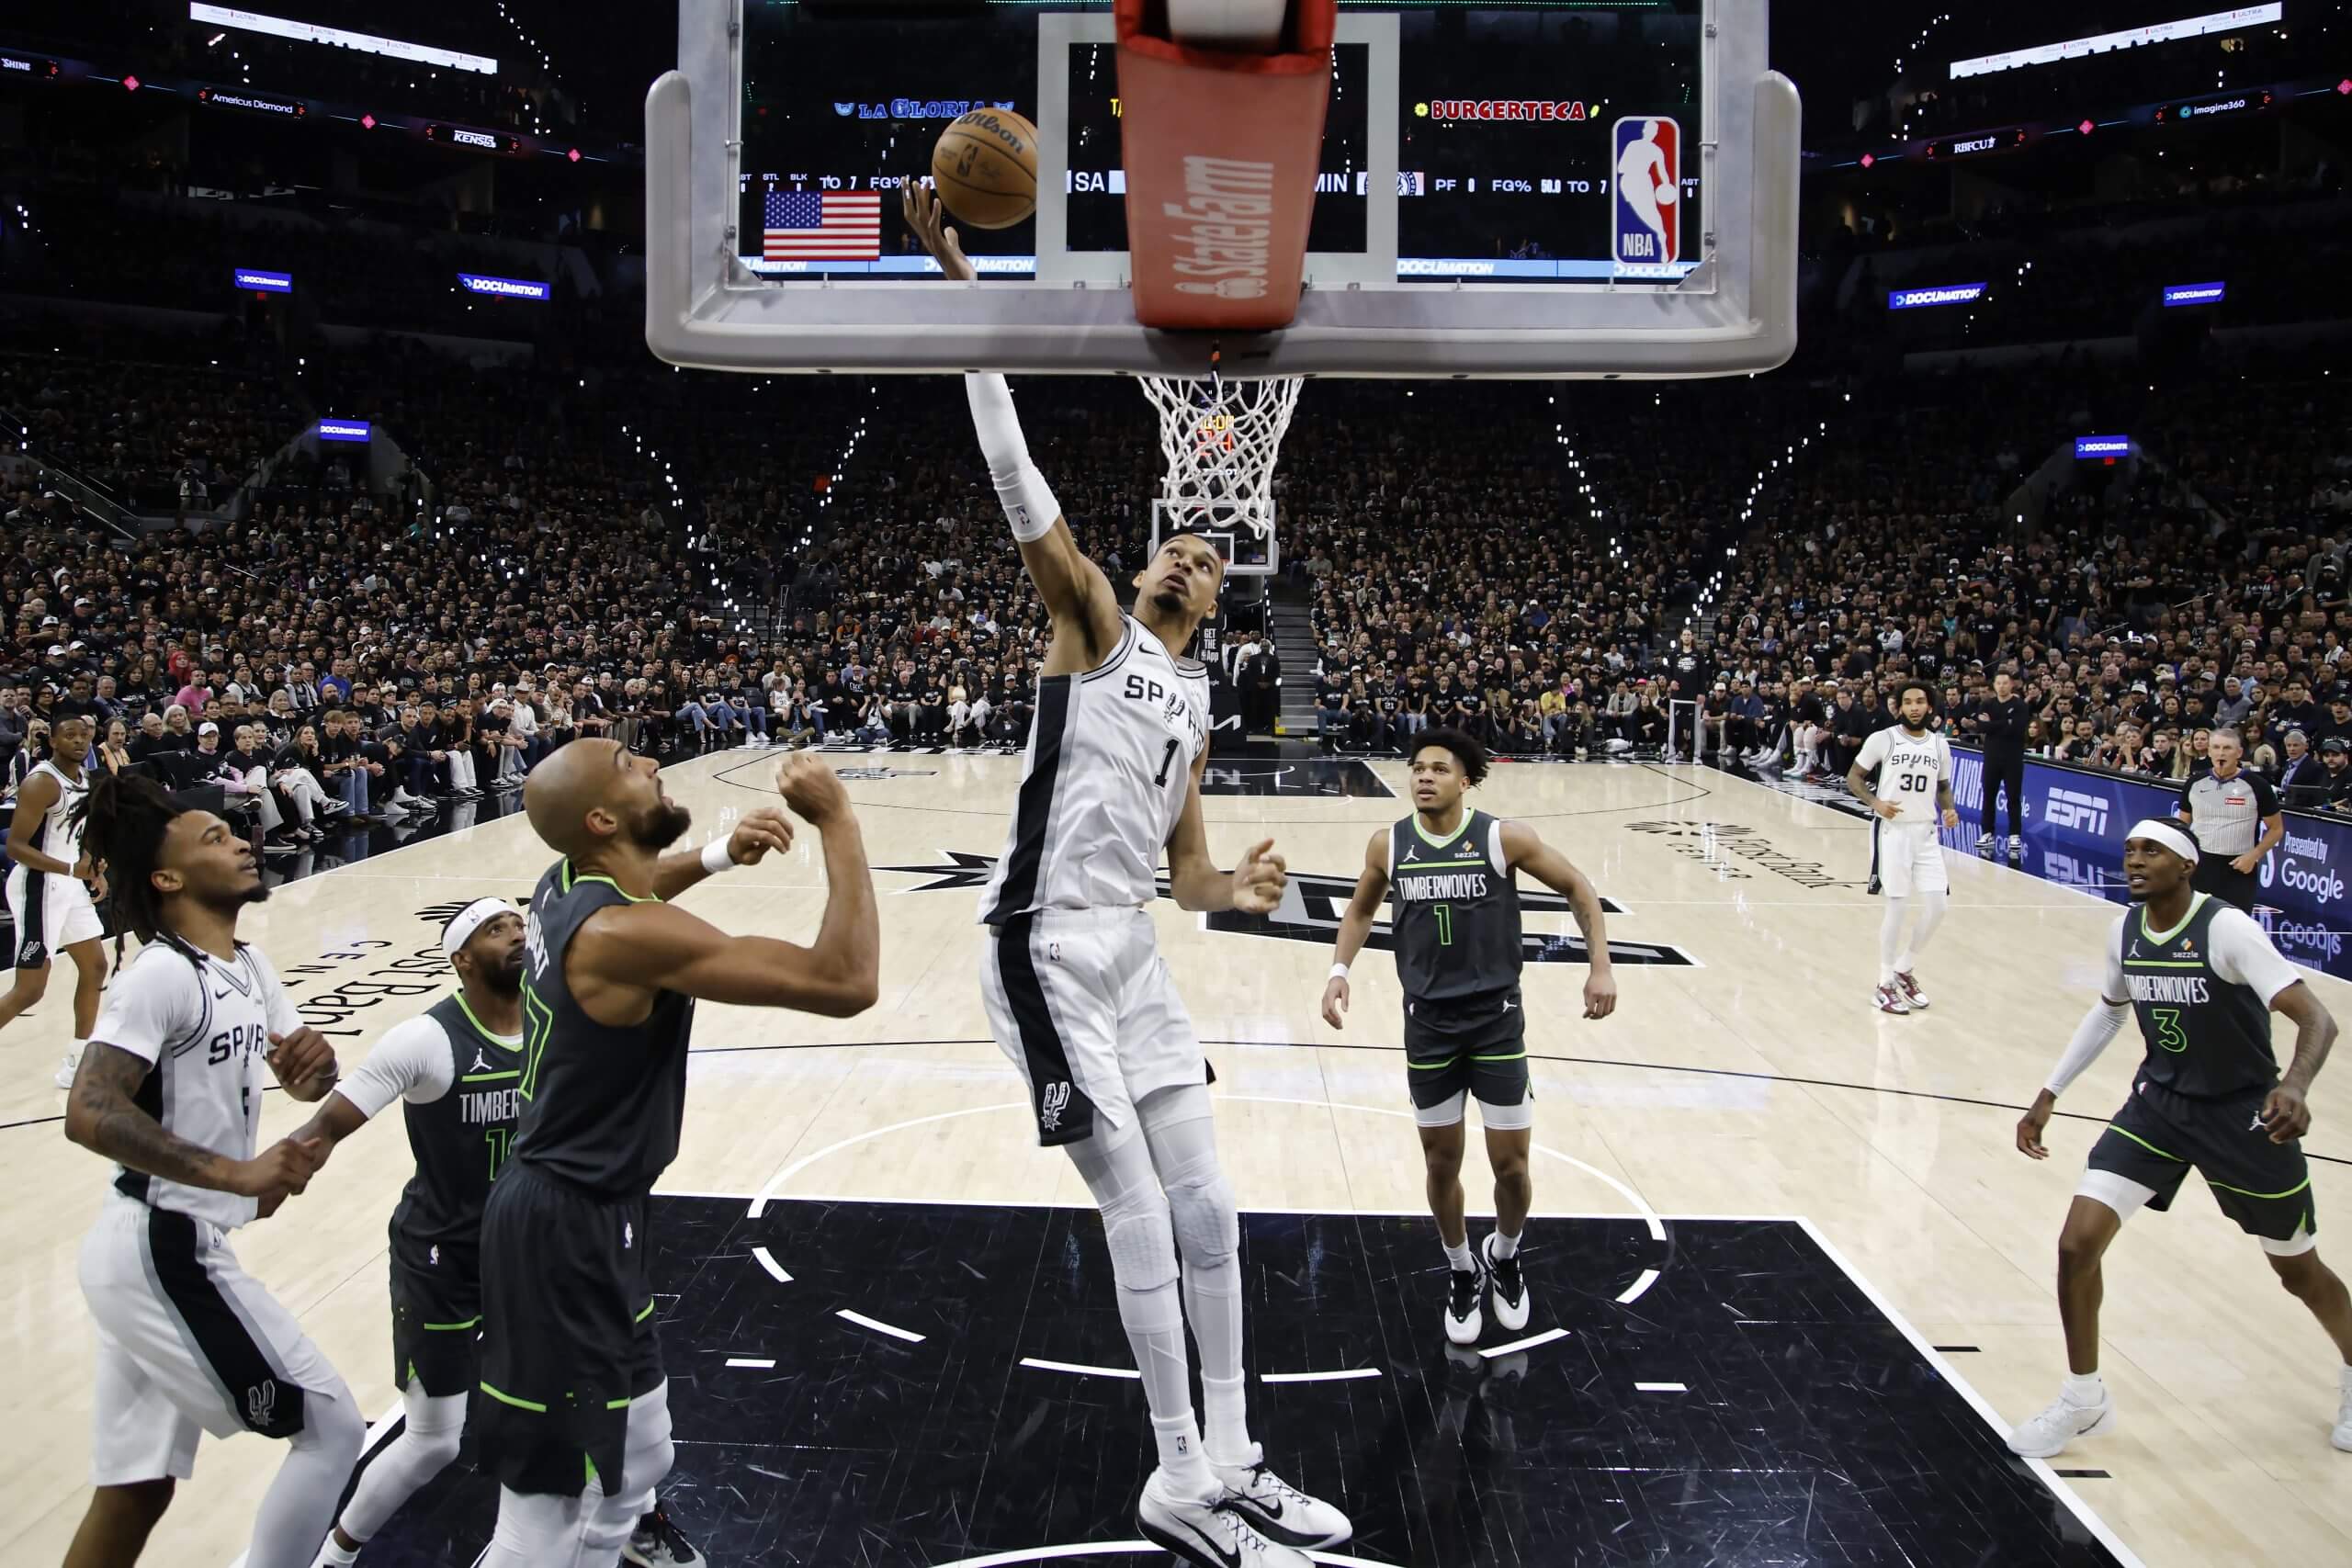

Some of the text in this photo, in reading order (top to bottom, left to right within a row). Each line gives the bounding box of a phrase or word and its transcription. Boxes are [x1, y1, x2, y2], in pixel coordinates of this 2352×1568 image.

[212, 94, 293, 114] Americus Diamond
[859, 104, 888, 118] LA
[1431, 100, 1586, 120] BURGERTECA
[2193, 99, 2245, 115] imagine360
[956, 112, 1024, 154] Wilson
[819, 176, 842, 189] TO
[1075, 172, 1105, 192] SA
[1435, 179, 1457, 191] PF
[1492, 179, 1532, 193] FG%
[1567, 180, 1589, 193] TO
[1600, 180, 1607, 194] 7
[1623, 233, 1655, 256] NBA
[472, 278, 544, 297] DOCUMATION
[1905, 288, 1981, 305] DOCUMATION
[1204, 627, 1216, 639] GET
[1204, 638, 1216, 649] THE
[1206, 649, 1219, 662] App
[1153, 737, 1182, 791] 1
[1900, 773, 1928, 793] 30
[2044, 786, 2109, 836] ESPN
[2284, 830, 2318, 860] Presented
[2318, 838, 2328, 864] by
[1397, 874, 1487, 903] TIMBERWOLVES
[2281, 857, 2344, 904] Google
[1433, 904, 1453, 946] 1
[2124, 974, 2210, 1007] TIMBERWOLVES
[2153, 1009, 2188, 1053] 3
[209, 1023, 267, 1066] SPUR
